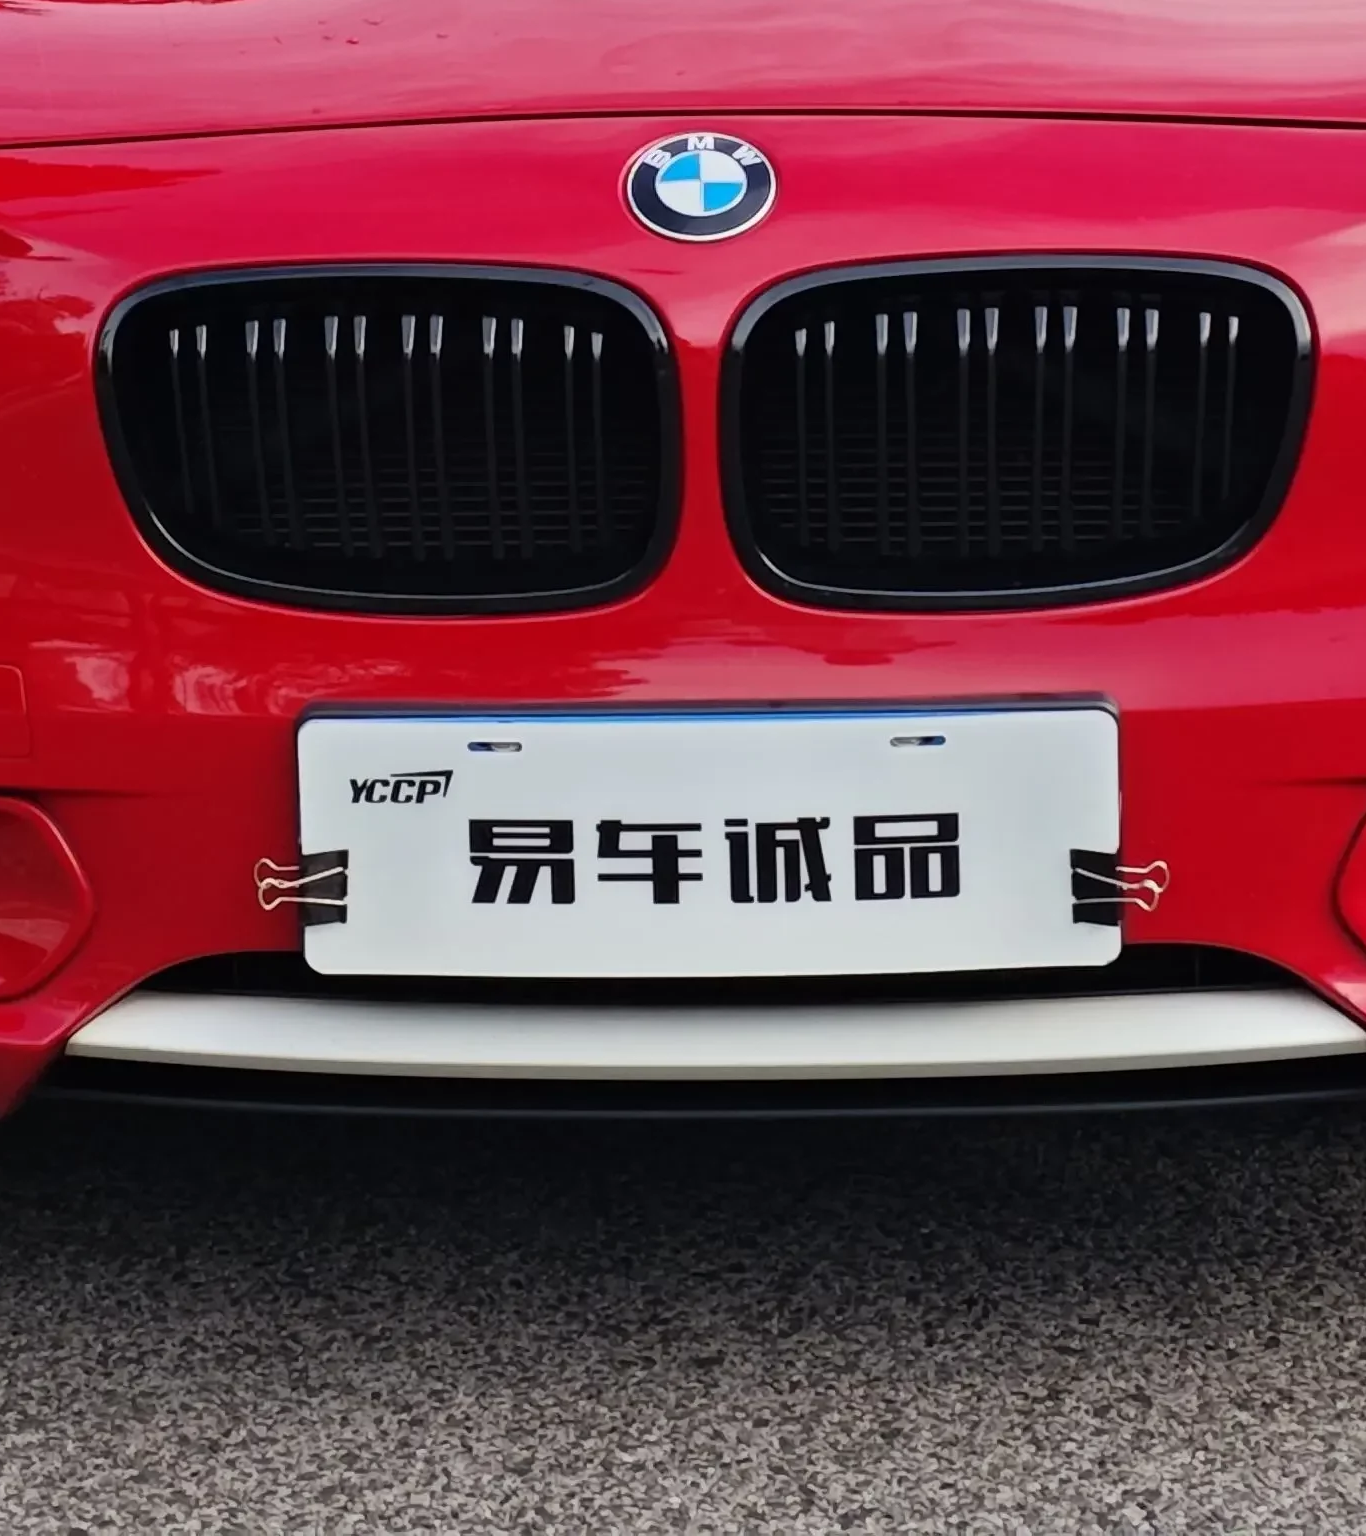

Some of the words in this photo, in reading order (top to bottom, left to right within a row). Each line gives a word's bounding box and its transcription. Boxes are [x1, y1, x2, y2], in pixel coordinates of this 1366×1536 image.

[642, 135, 764, 169] BMW
[349, 775, 445, 804] YCCP
[468, 813, 960, 904] 易车诚品
